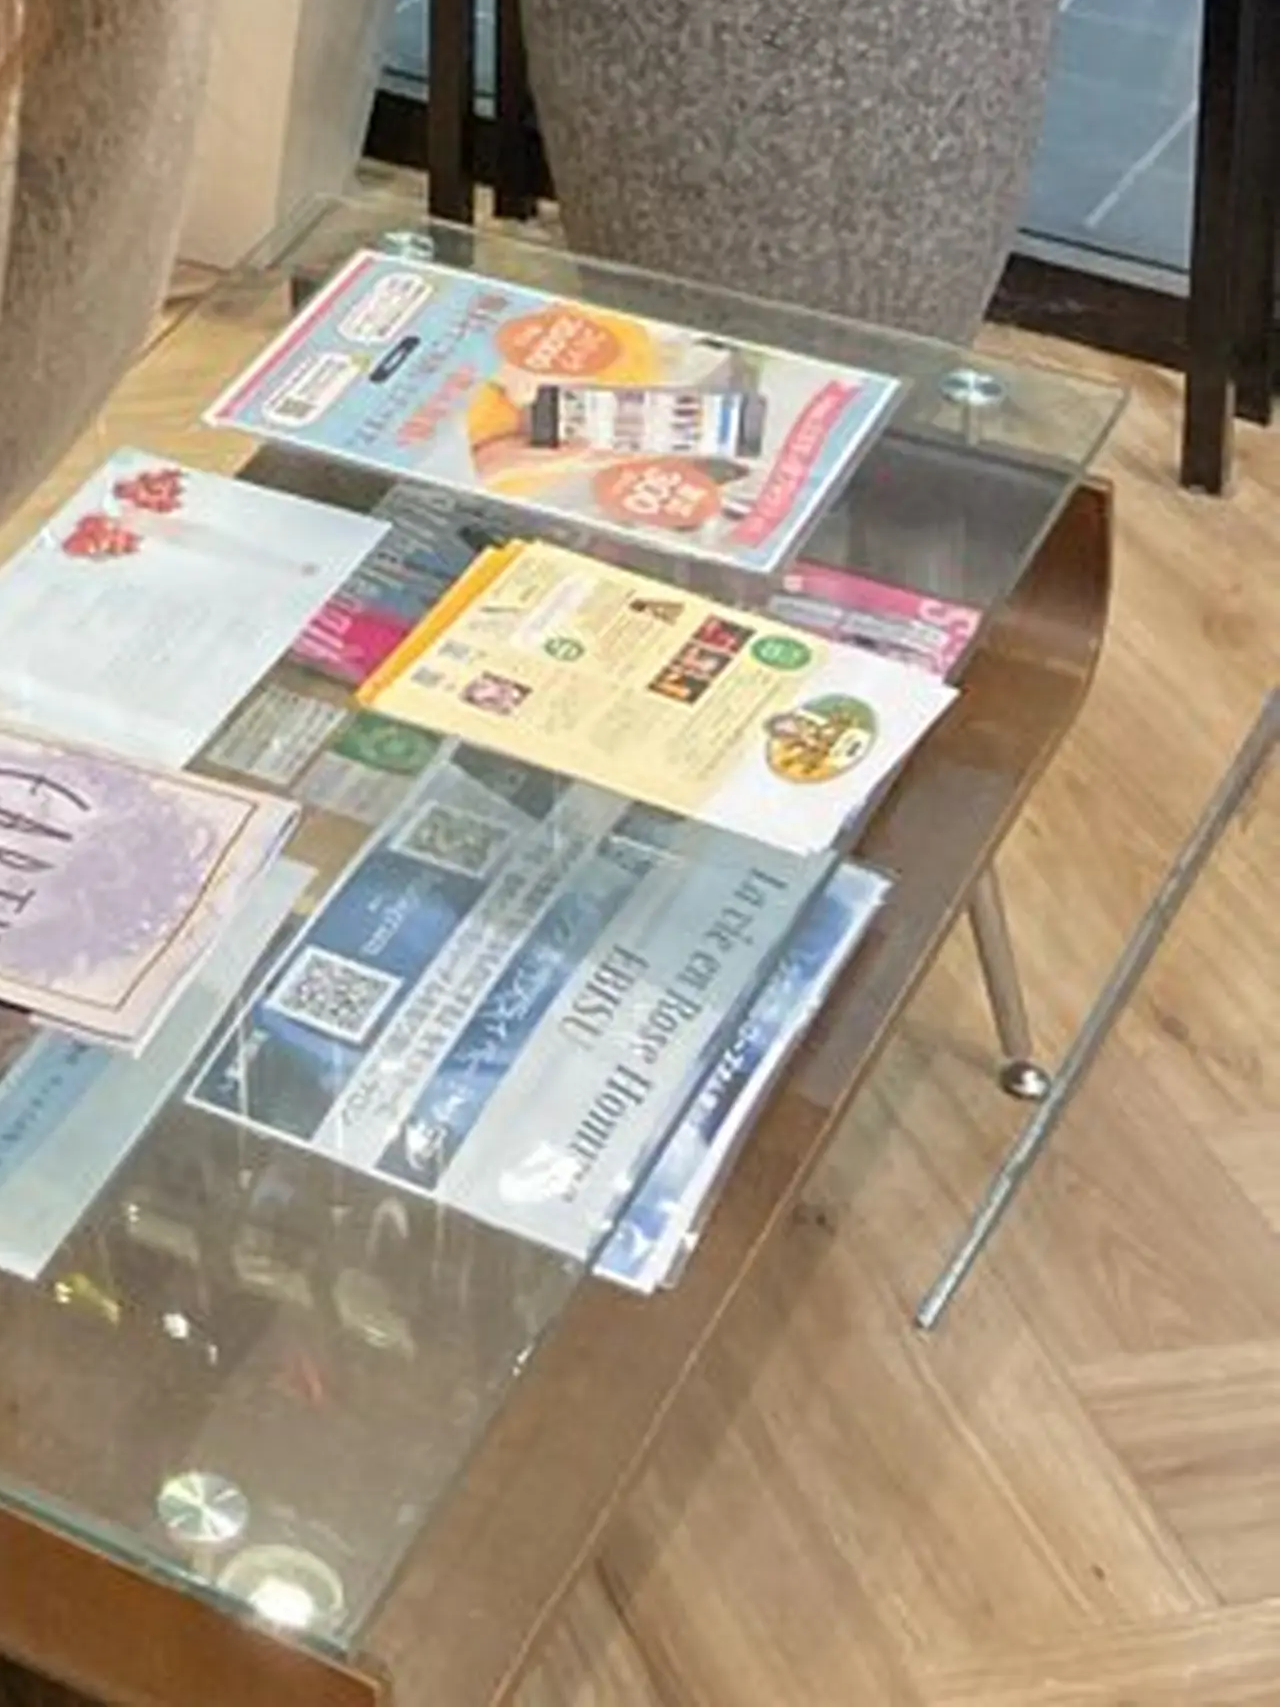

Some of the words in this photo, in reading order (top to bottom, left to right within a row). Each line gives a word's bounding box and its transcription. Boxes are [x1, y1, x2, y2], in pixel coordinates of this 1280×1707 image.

[733, 867, 787, 908] La
[703, 907, 757, 951] vie
[677, 951, 722, 993] en
[559, 945, 651, 1048] EBISU
[642, 987, 702, 1068] Rose
